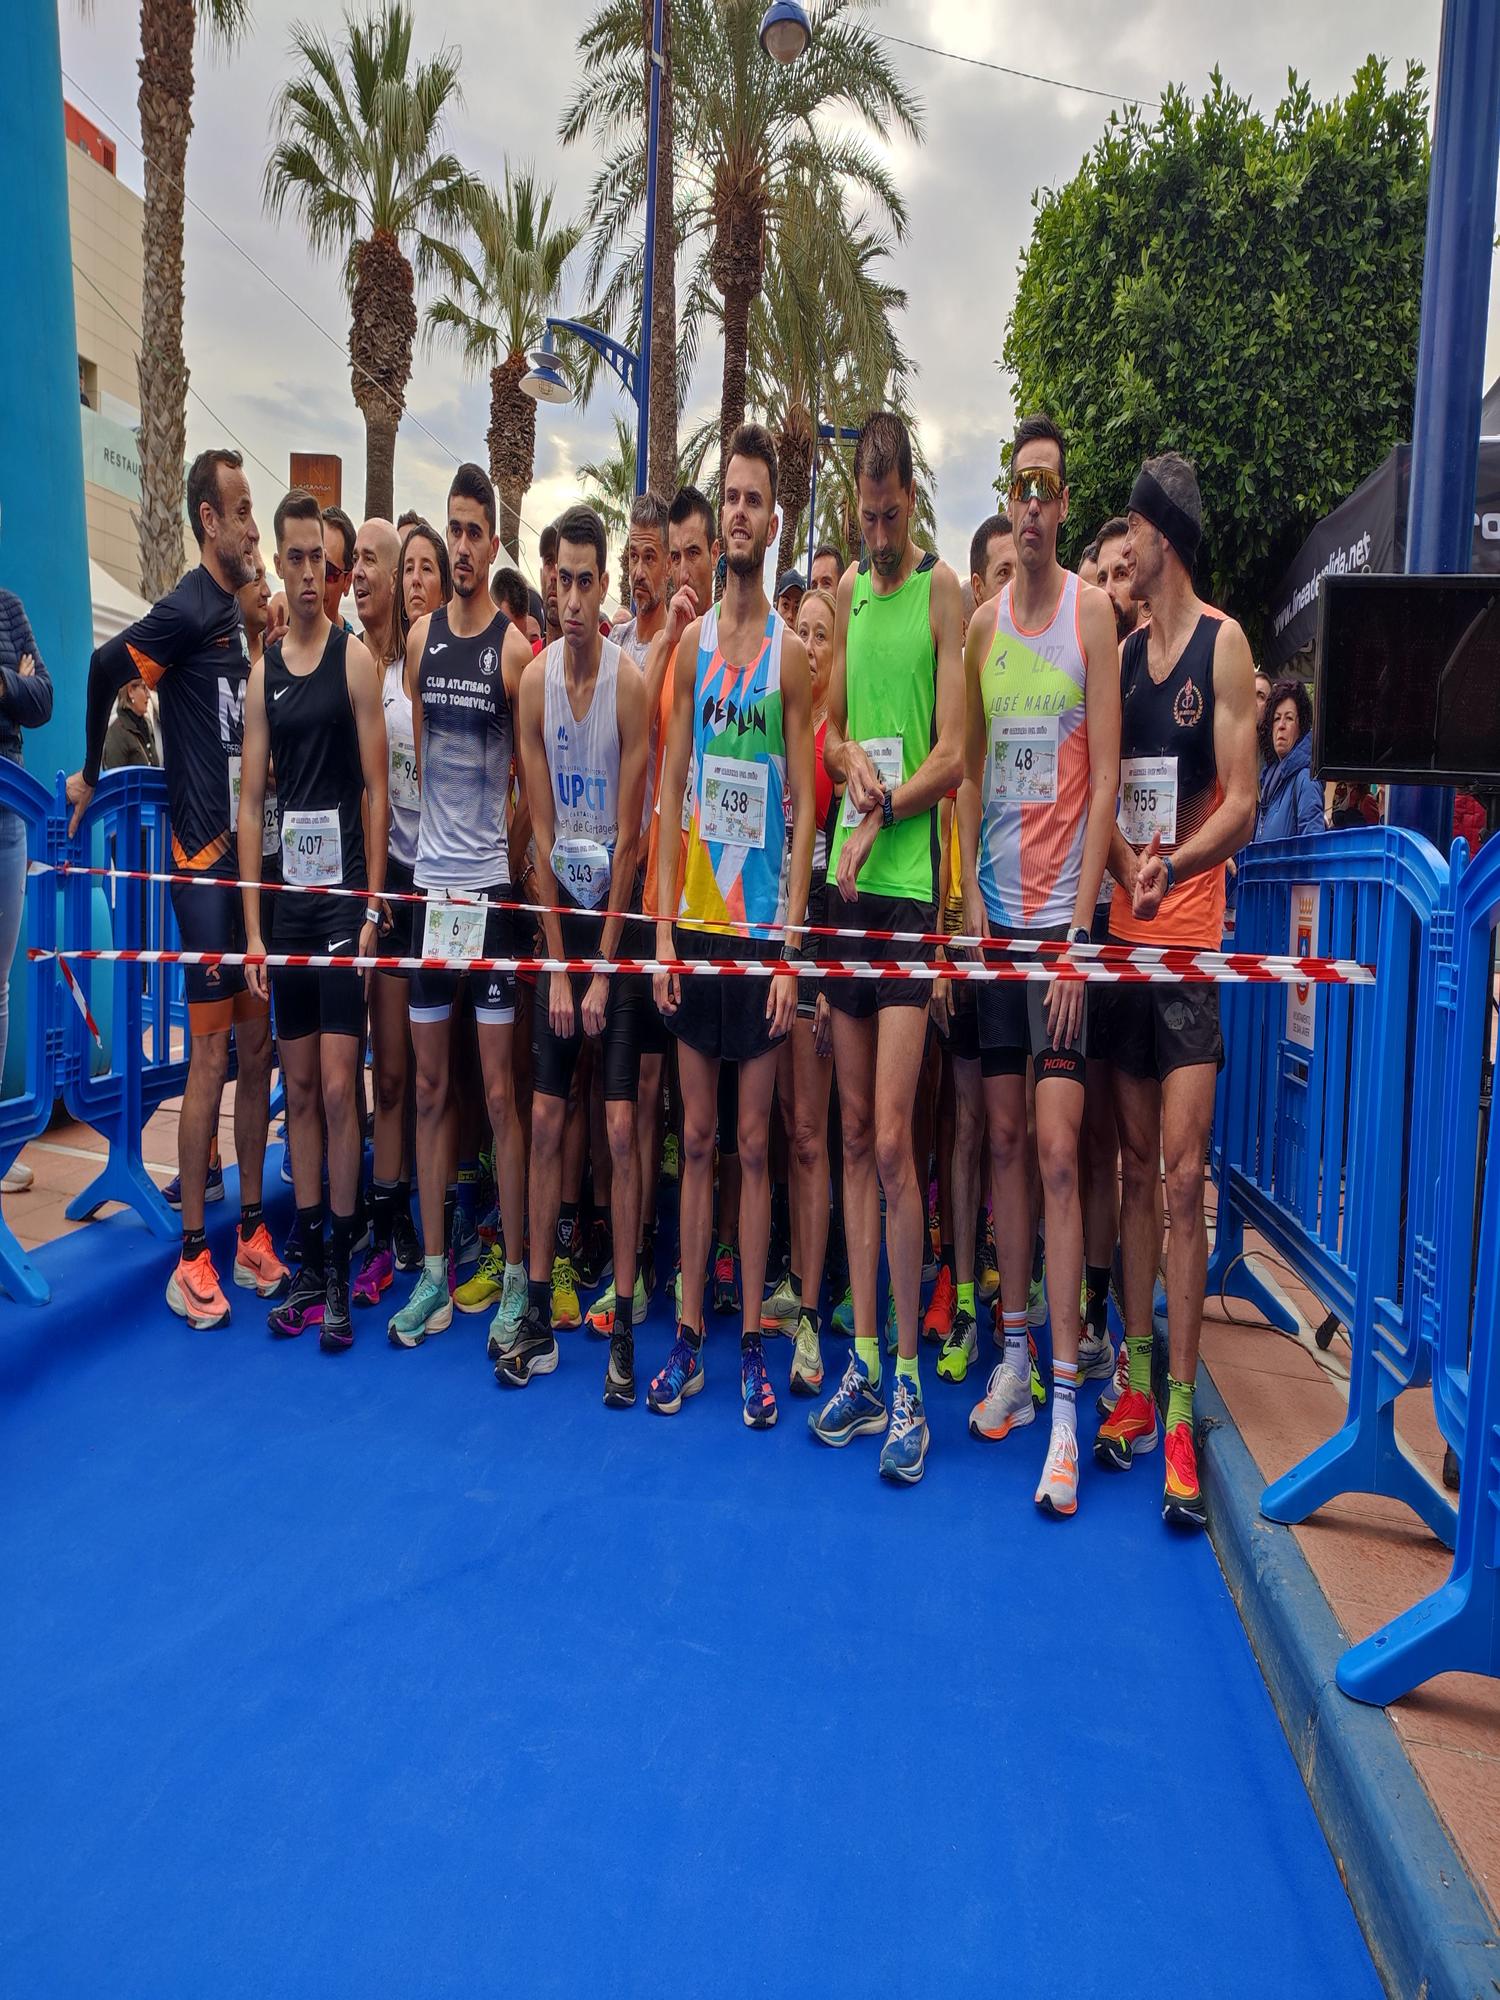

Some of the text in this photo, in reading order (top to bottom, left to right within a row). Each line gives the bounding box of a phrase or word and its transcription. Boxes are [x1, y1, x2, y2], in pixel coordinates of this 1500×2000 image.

[1031, 645, 1065, 674] LPZ
[426, 676, 491, 695] CLUB ATLETISMO
[449, 694, 496, 715] TORREVIEJA
[989, 691, 1066, 713] JOSÉ MARÍA
[702, 695, 767, 737] BERLIN
[1014, 747, 1033, 771] 48
[557, 772, 608, 811] UPCT
[721, 788, 748, 814] 438
[1133, 788, 1157, 812] 955
[573, 819, 583, 833] de
[584, 820, 619, 836] Cartagena
[298, 836, 323, 855] 407
[567, 863, 592, 883] 343
[452, 916, 459, 936] 6
